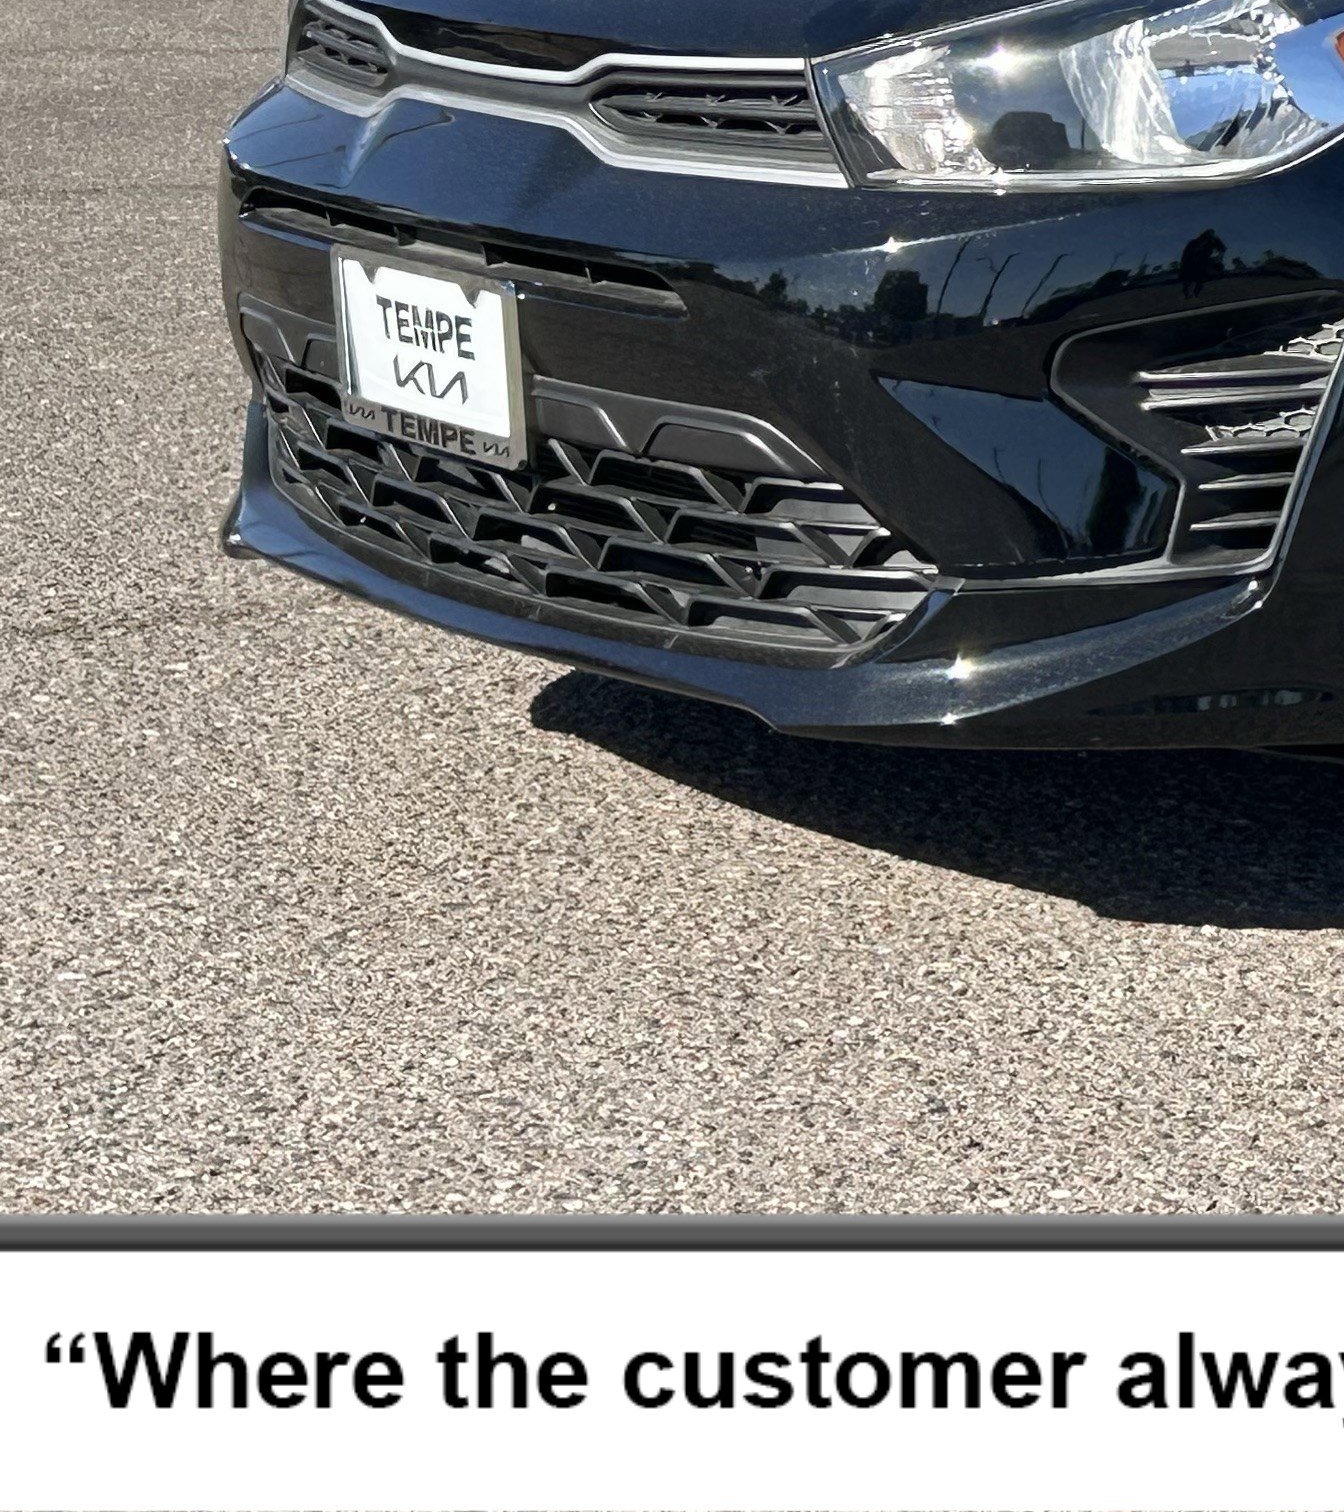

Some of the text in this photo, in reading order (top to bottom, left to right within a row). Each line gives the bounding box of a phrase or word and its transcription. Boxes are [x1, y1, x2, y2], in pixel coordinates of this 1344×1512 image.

[376, 295, 475, 361] TEMPE
[393, 354, 469, 405] KIA
[381, 405, 477, 456] TEMPE
